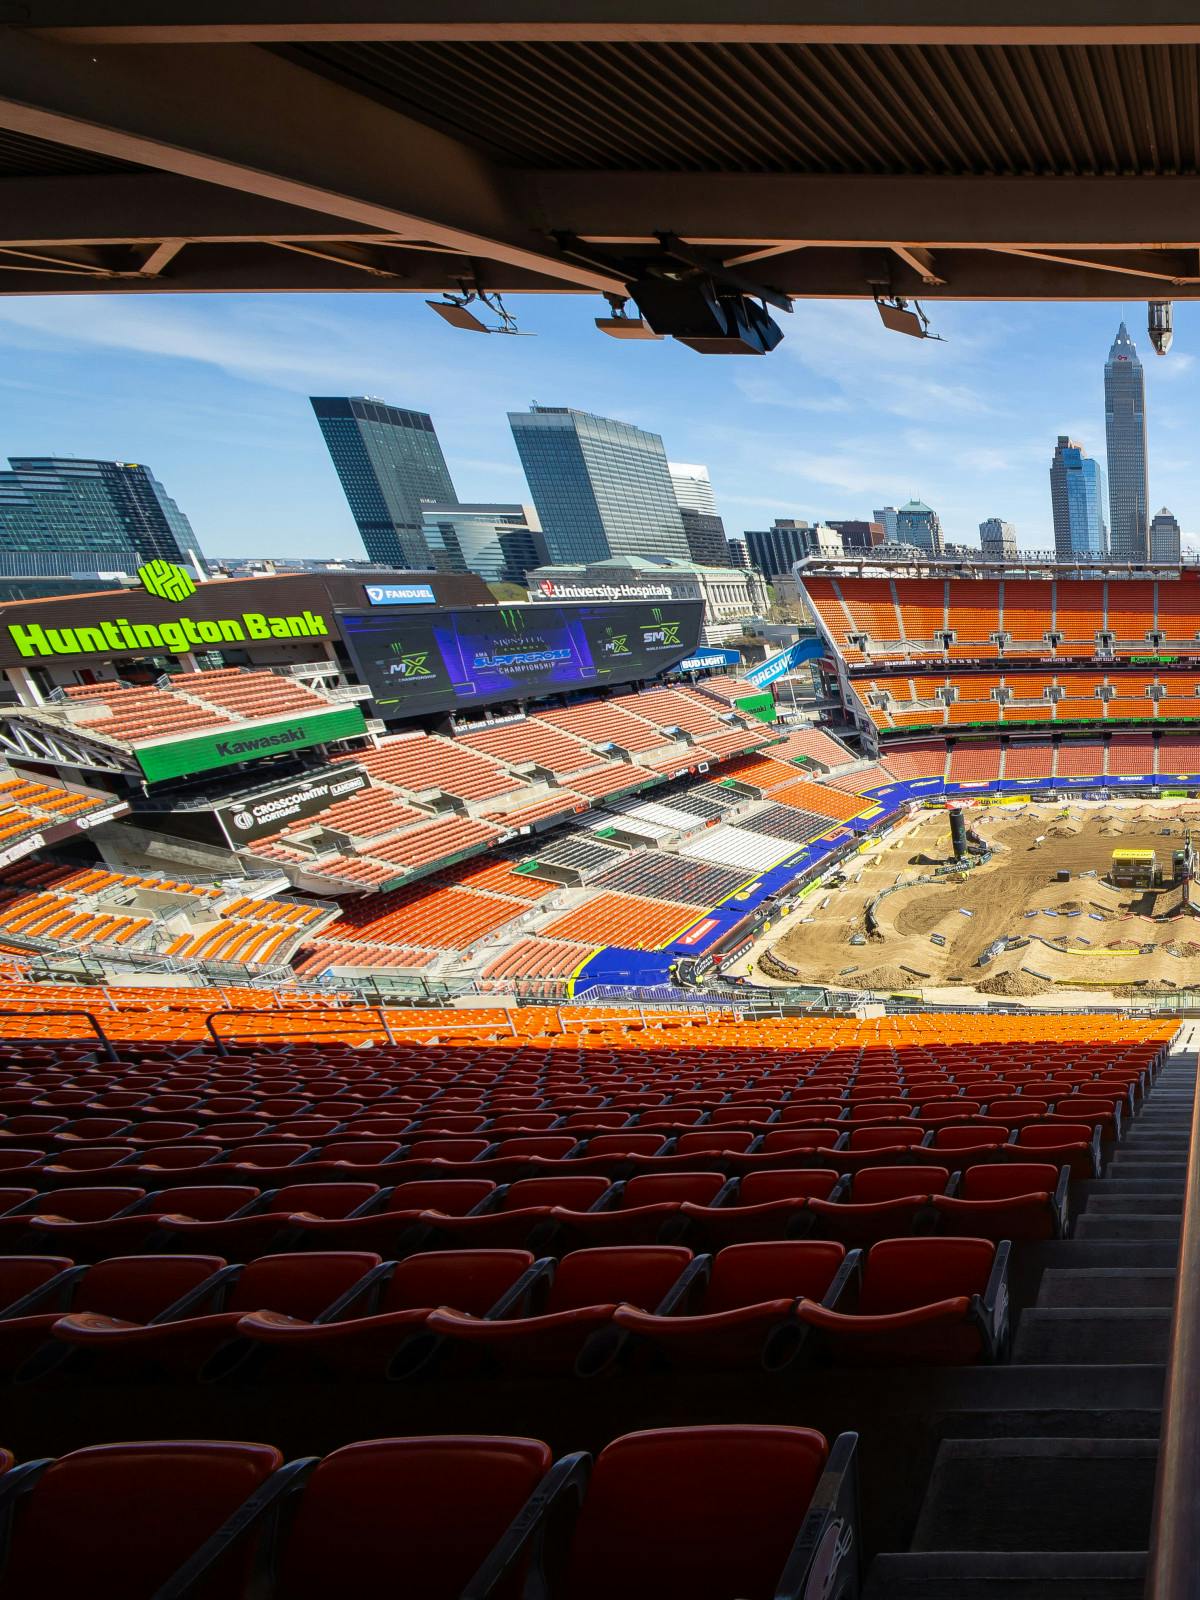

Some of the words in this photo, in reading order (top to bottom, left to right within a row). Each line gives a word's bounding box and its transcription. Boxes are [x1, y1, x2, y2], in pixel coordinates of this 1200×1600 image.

[385, 589, 434, 599] FANDUEL
[553, 585, 620, 599] University
[621, 584, 673, 598] Hospitals
[8, 617, 245, 657] Huntington
[242, 611, 329, 640] Bank
[643, 626, 681, 645] SMX
[499, 661, 556, 674] CHAMPIONSHIP
[681, 658, 701, 670] BUD
[701, 655, 726, 667] LIGHT
[751, 653, 794, 687] GRESSIVE
[215, 727, 306, 758] Kawasaki
[333, 779, 363, 794] LANDING
[252, 785, 329, 817] CROSSCOUNTRY
[257, 804, 301, 825] MORTGAGE
